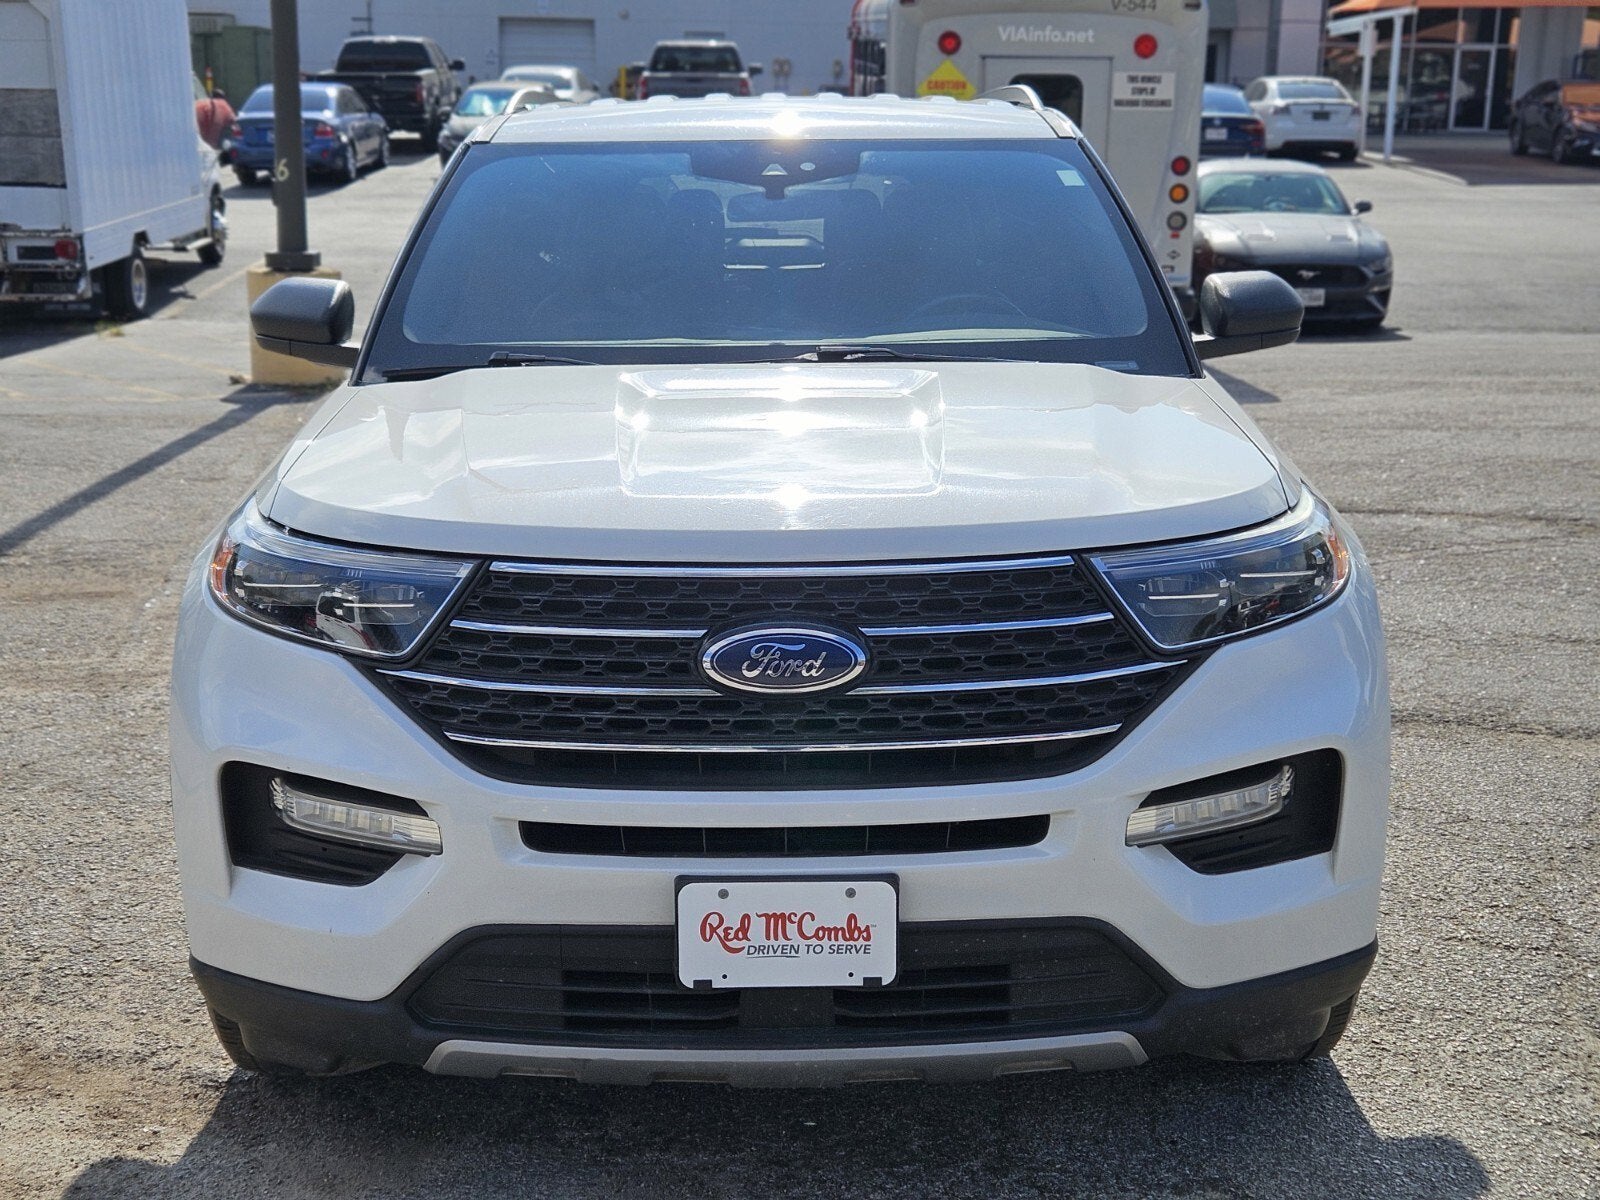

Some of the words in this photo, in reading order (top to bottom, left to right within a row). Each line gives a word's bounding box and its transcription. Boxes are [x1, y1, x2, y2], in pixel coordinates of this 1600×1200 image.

[998, 25, 1095, 43] VIAinfo.net
[741, 642, 827, 678] Ford
[699, 911, 751, 954] Red
[755, 911, 872, 942] McCombs
[746, 944, 801, 956] DRIVEN
[805, 944, 824, 955] TO
[828, 944, 871, 955] SERVE
